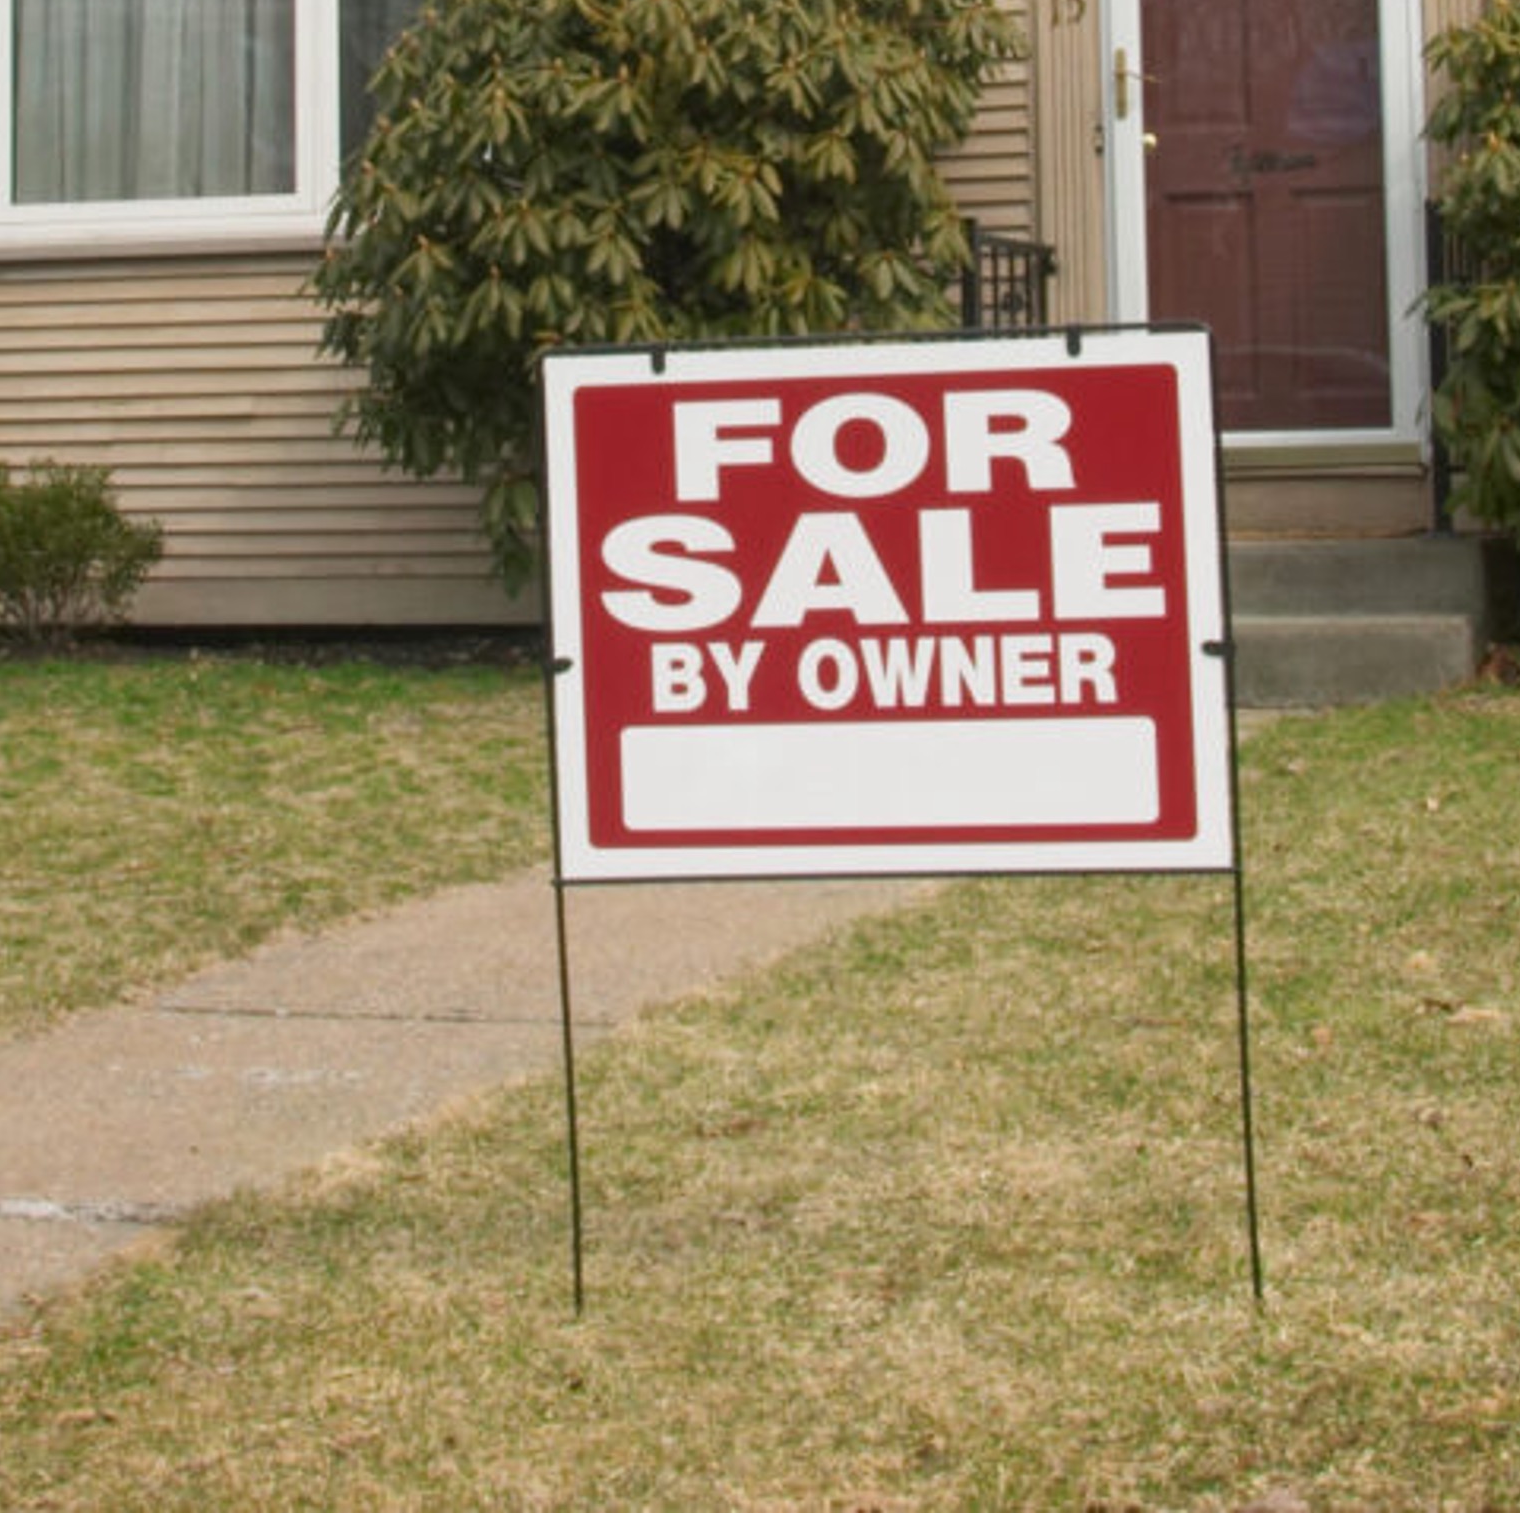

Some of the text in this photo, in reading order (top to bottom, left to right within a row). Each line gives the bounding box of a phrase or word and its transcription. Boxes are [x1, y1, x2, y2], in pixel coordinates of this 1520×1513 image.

[672, 389, 1077, 502] FOR
[600, 502, 1167, 632] SALE
[650, 632, 1118, 713] BY OWNER
